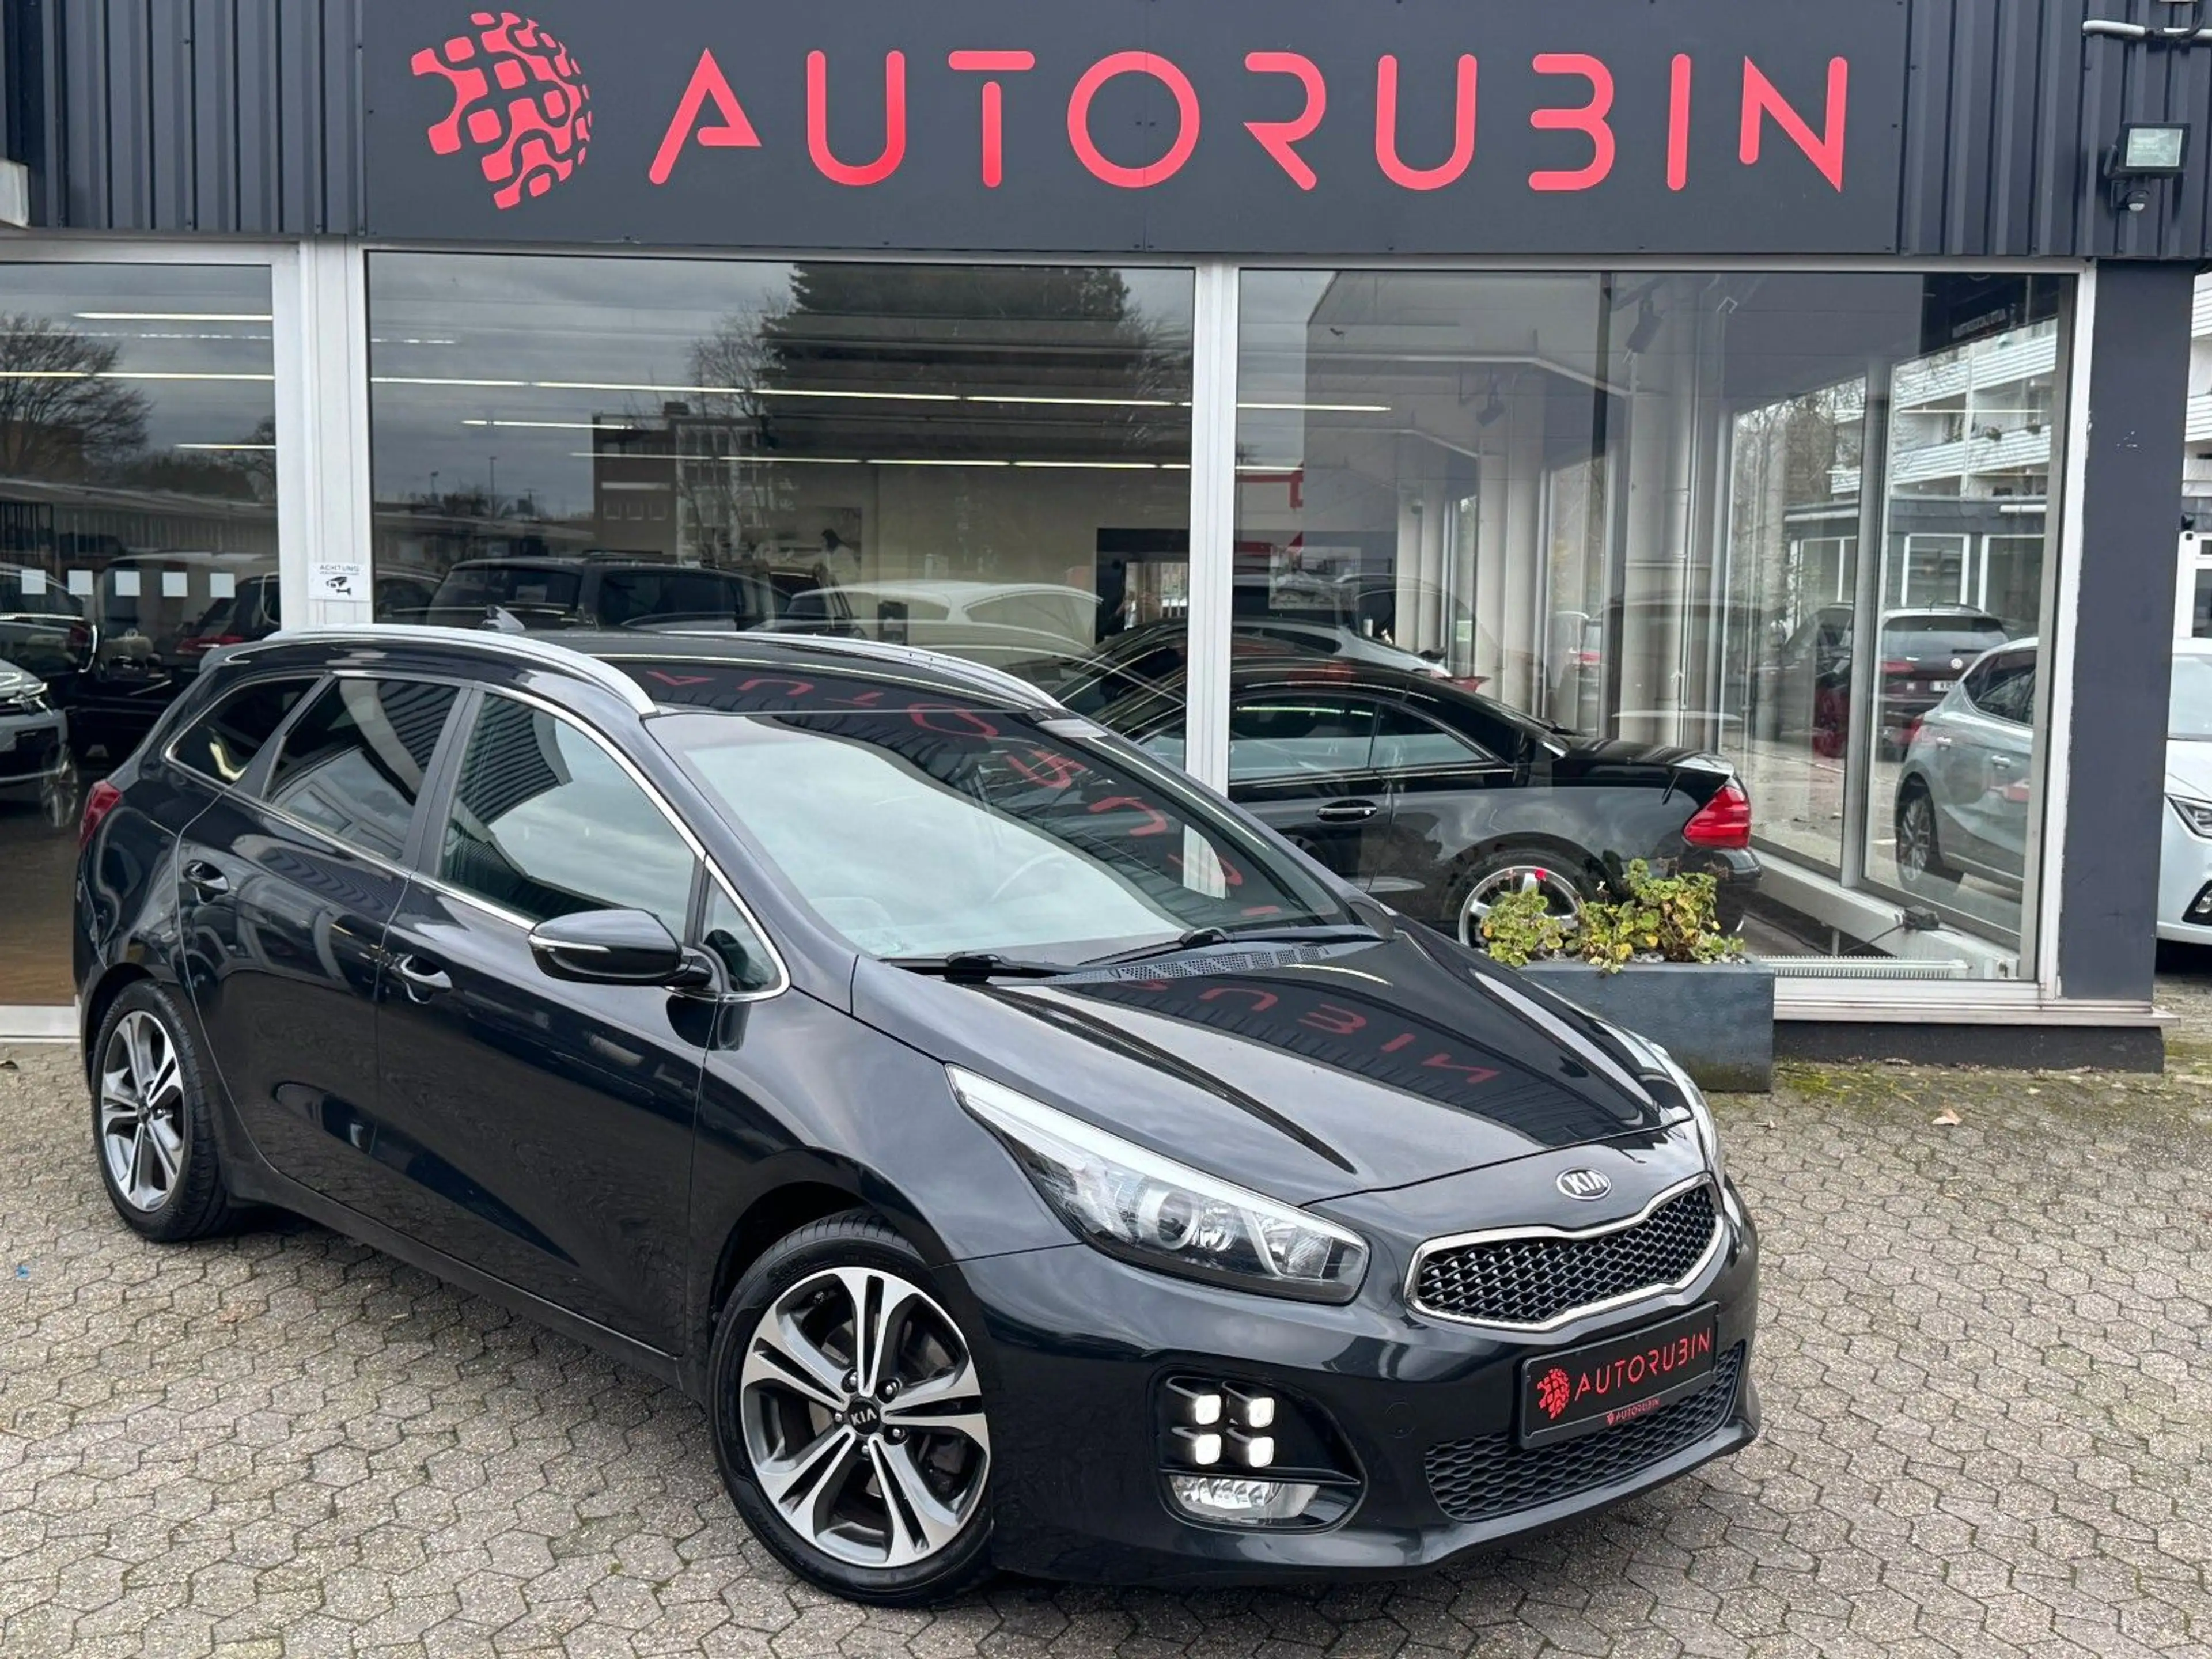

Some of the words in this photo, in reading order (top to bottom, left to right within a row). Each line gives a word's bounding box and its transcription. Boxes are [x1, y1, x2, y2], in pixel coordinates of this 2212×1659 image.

[649, 47, 1847, 190] AUTORUBIN
[1563, 1171, 1608, 1194] KIA
[1574, 1327, 1710, 1402] AUTORUBIN
[850, 1408, 877, 1426] KIA
[1616, 1398, 1660, 1421] AUTORUBIN
